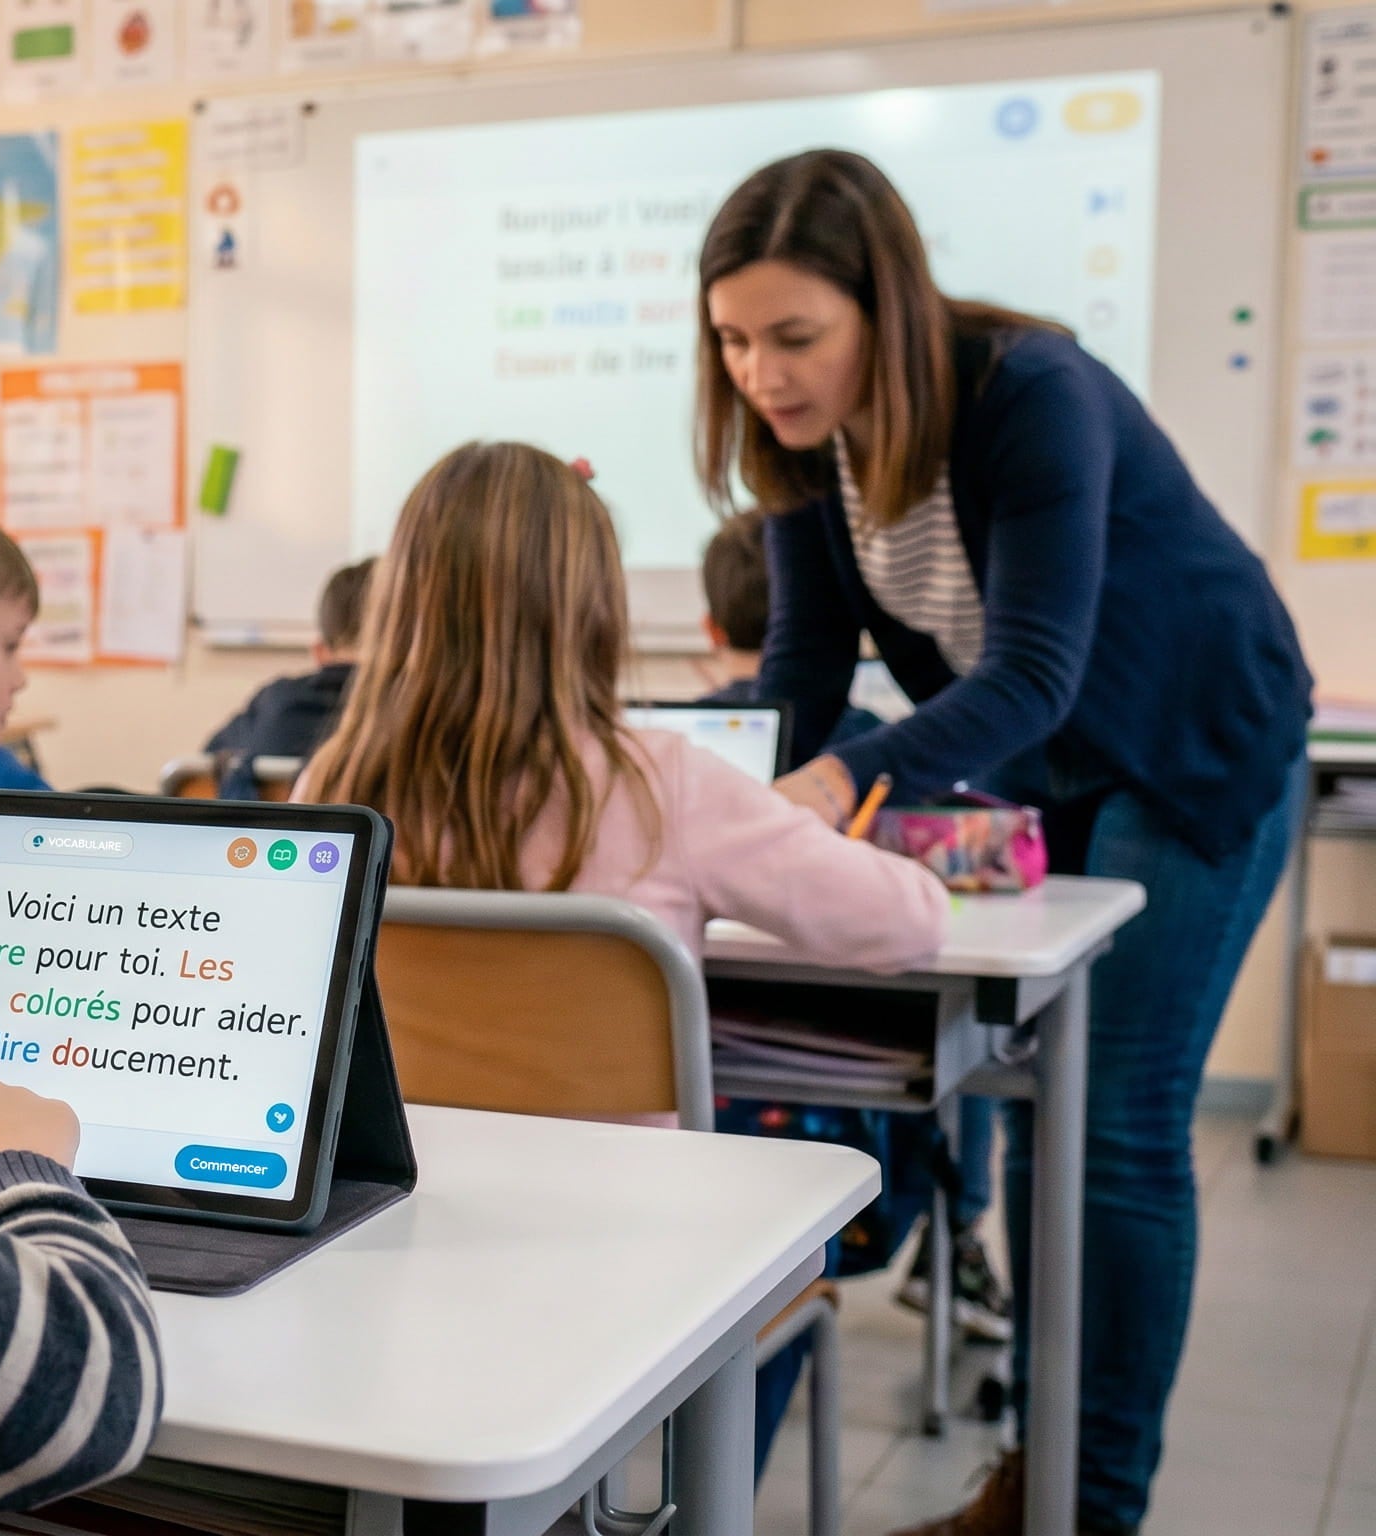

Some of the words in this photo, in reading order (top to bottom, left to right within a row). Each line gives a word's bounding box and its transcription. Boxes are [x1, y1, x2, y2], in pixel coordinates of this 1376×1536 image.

[48, 837, 122, 852] VOCABULAIRE
[7, 890, 77, 922] Voici
[87, 903, 124, 925] un
[136, 901, 221, 932] texte
[35, 947, 107, 974] pour
[119, 948, 165, 977] toi.
[179, 950, 235, 982] Les
[9, 987, 121, 1021] colorés
[131, 1002, 206, 1030] pour
[217, 1003, 307, 1037] aider.
[52, 1037, 240, 1081] doucement.
[190, 1157, 269, 1176] Commencer
